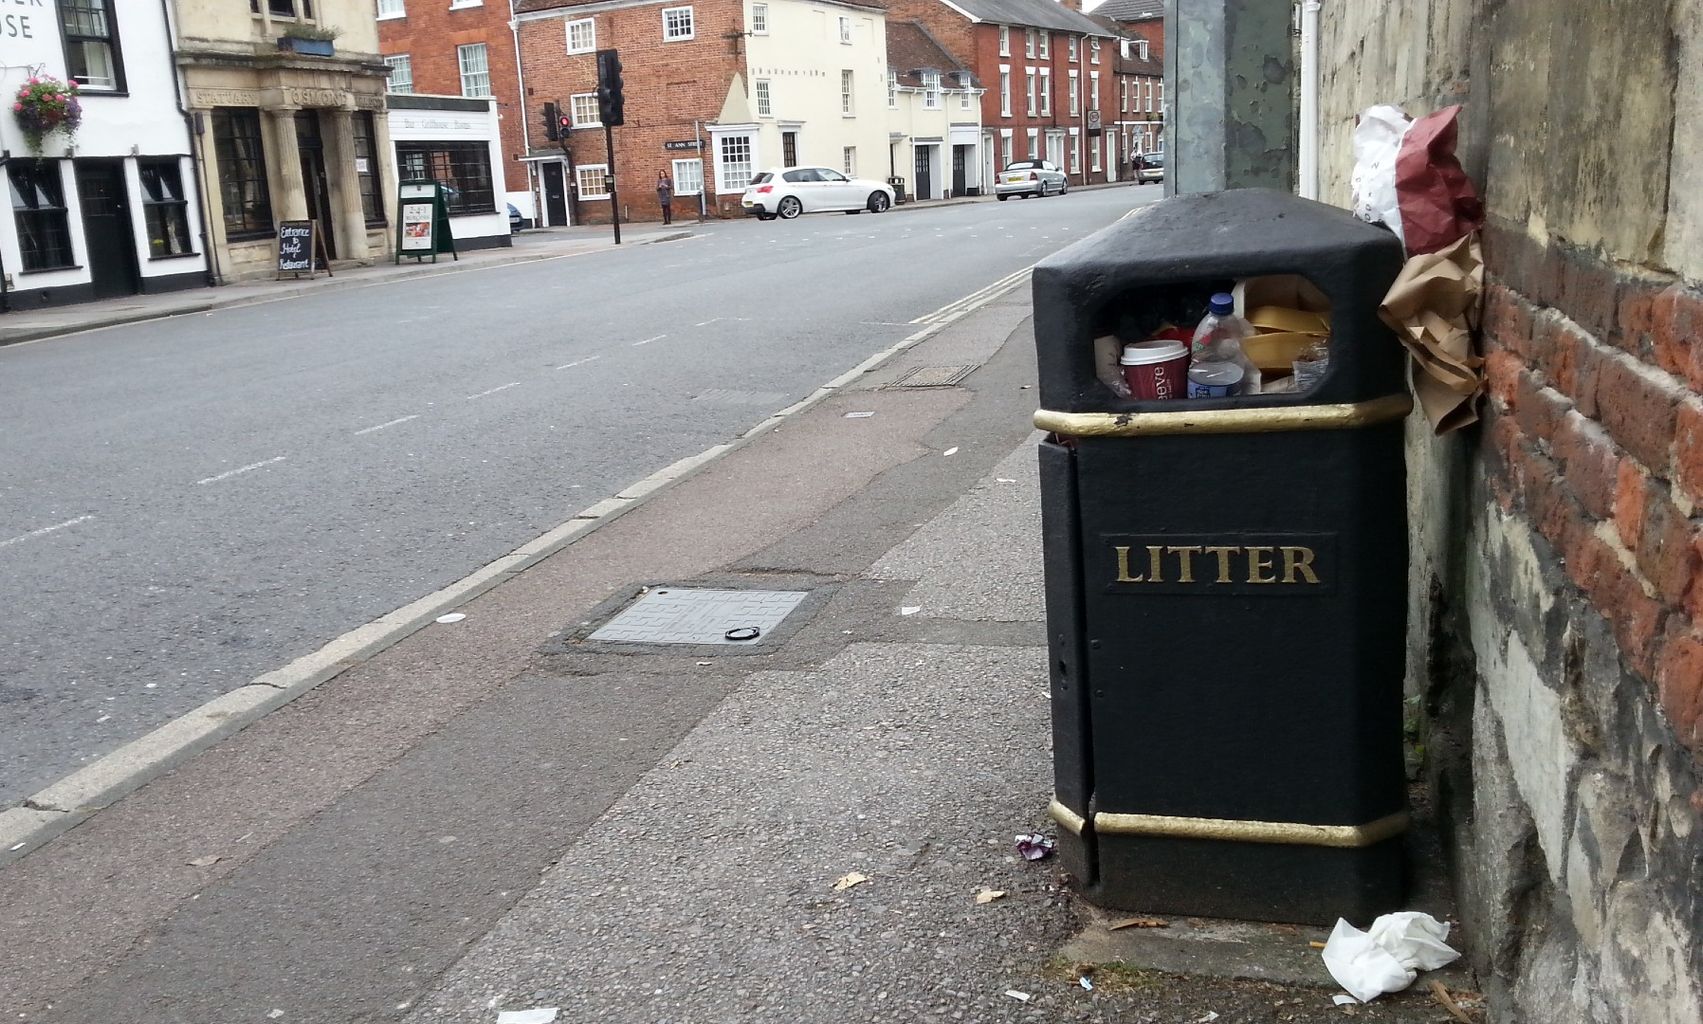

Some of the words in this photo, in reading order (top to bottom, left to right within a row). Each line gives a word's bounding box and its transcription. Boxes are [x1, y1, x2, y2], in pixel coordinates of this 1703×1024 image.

[0, 14, 33, 39] SE
[281, 226, 310, 239] Entrance
[280, 258, 309, 269] Restaurant
[1115, 545, 1320, 584] LITTER
